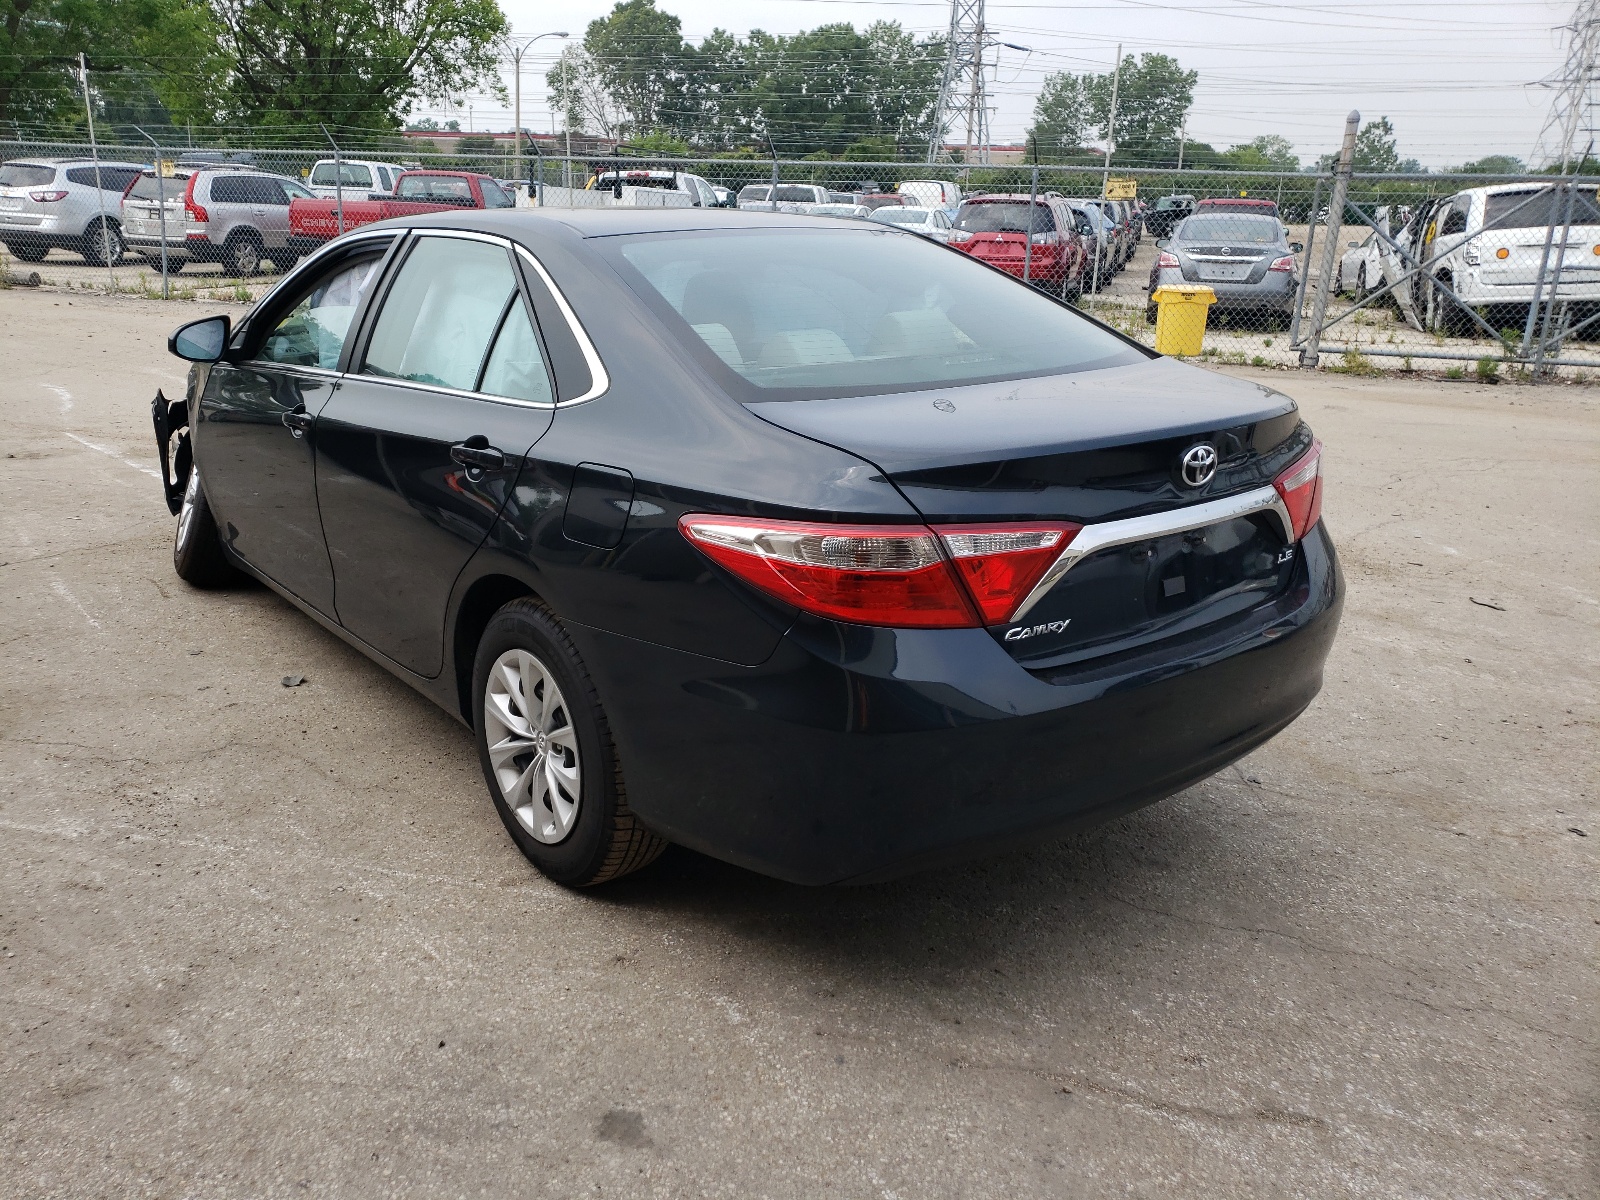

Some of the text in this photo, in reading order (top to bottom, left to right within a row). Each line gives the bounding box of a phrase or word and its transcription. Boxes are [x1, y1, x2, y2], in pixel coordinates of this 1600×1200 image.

[301, 218, 373, 229] CHEVOLE
[1277, 549, 1293, 564] LE
[1004, 619, 1072, 641] CAMRY
